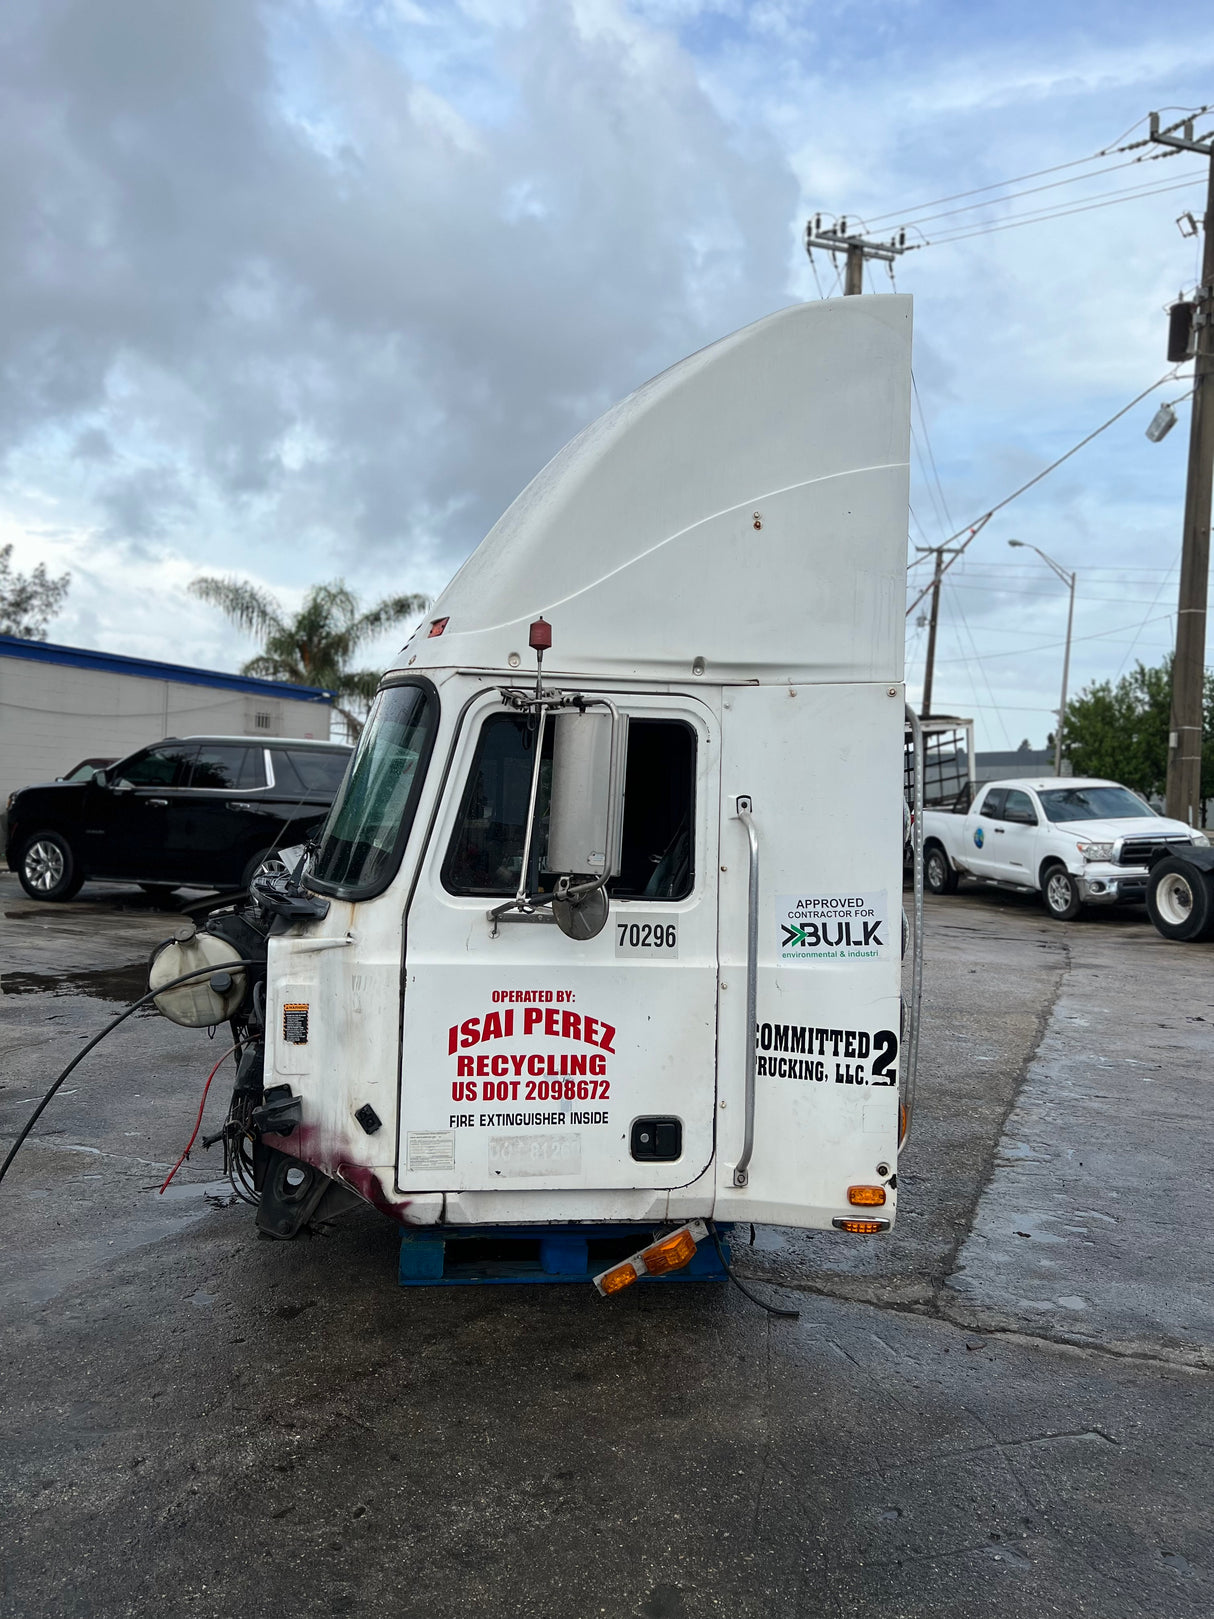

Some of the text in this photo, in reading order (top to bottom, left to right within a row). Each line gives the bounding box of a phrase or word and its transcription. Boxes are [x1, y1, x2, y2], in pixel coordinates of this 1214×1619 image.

[787, 909, 875, 919] CONTRACTOR FOR
[796, 897, 865, 909] APPROVED
[617, 923, 677, 948] 70296
[800, 920, 884, 947] BULK
[782, 950, 838, 959] environmental
[839, 950, 846, 958] &
[491, 990, 576, 1003] OPERATED BY:
[448, 1008, 616, 1056] ISAI PEREZ
[456, 1054, 607, 1077] RECYCLING
[871, 1030, 898, 1086] 2
[756, 1055, 869, 1086] RUCKING, LLC.
[452, 1080, 611, 1102] US DOT 2098672
[449, 1111, 609, 1128] FIRE EXTINGUISHER INSIDE
